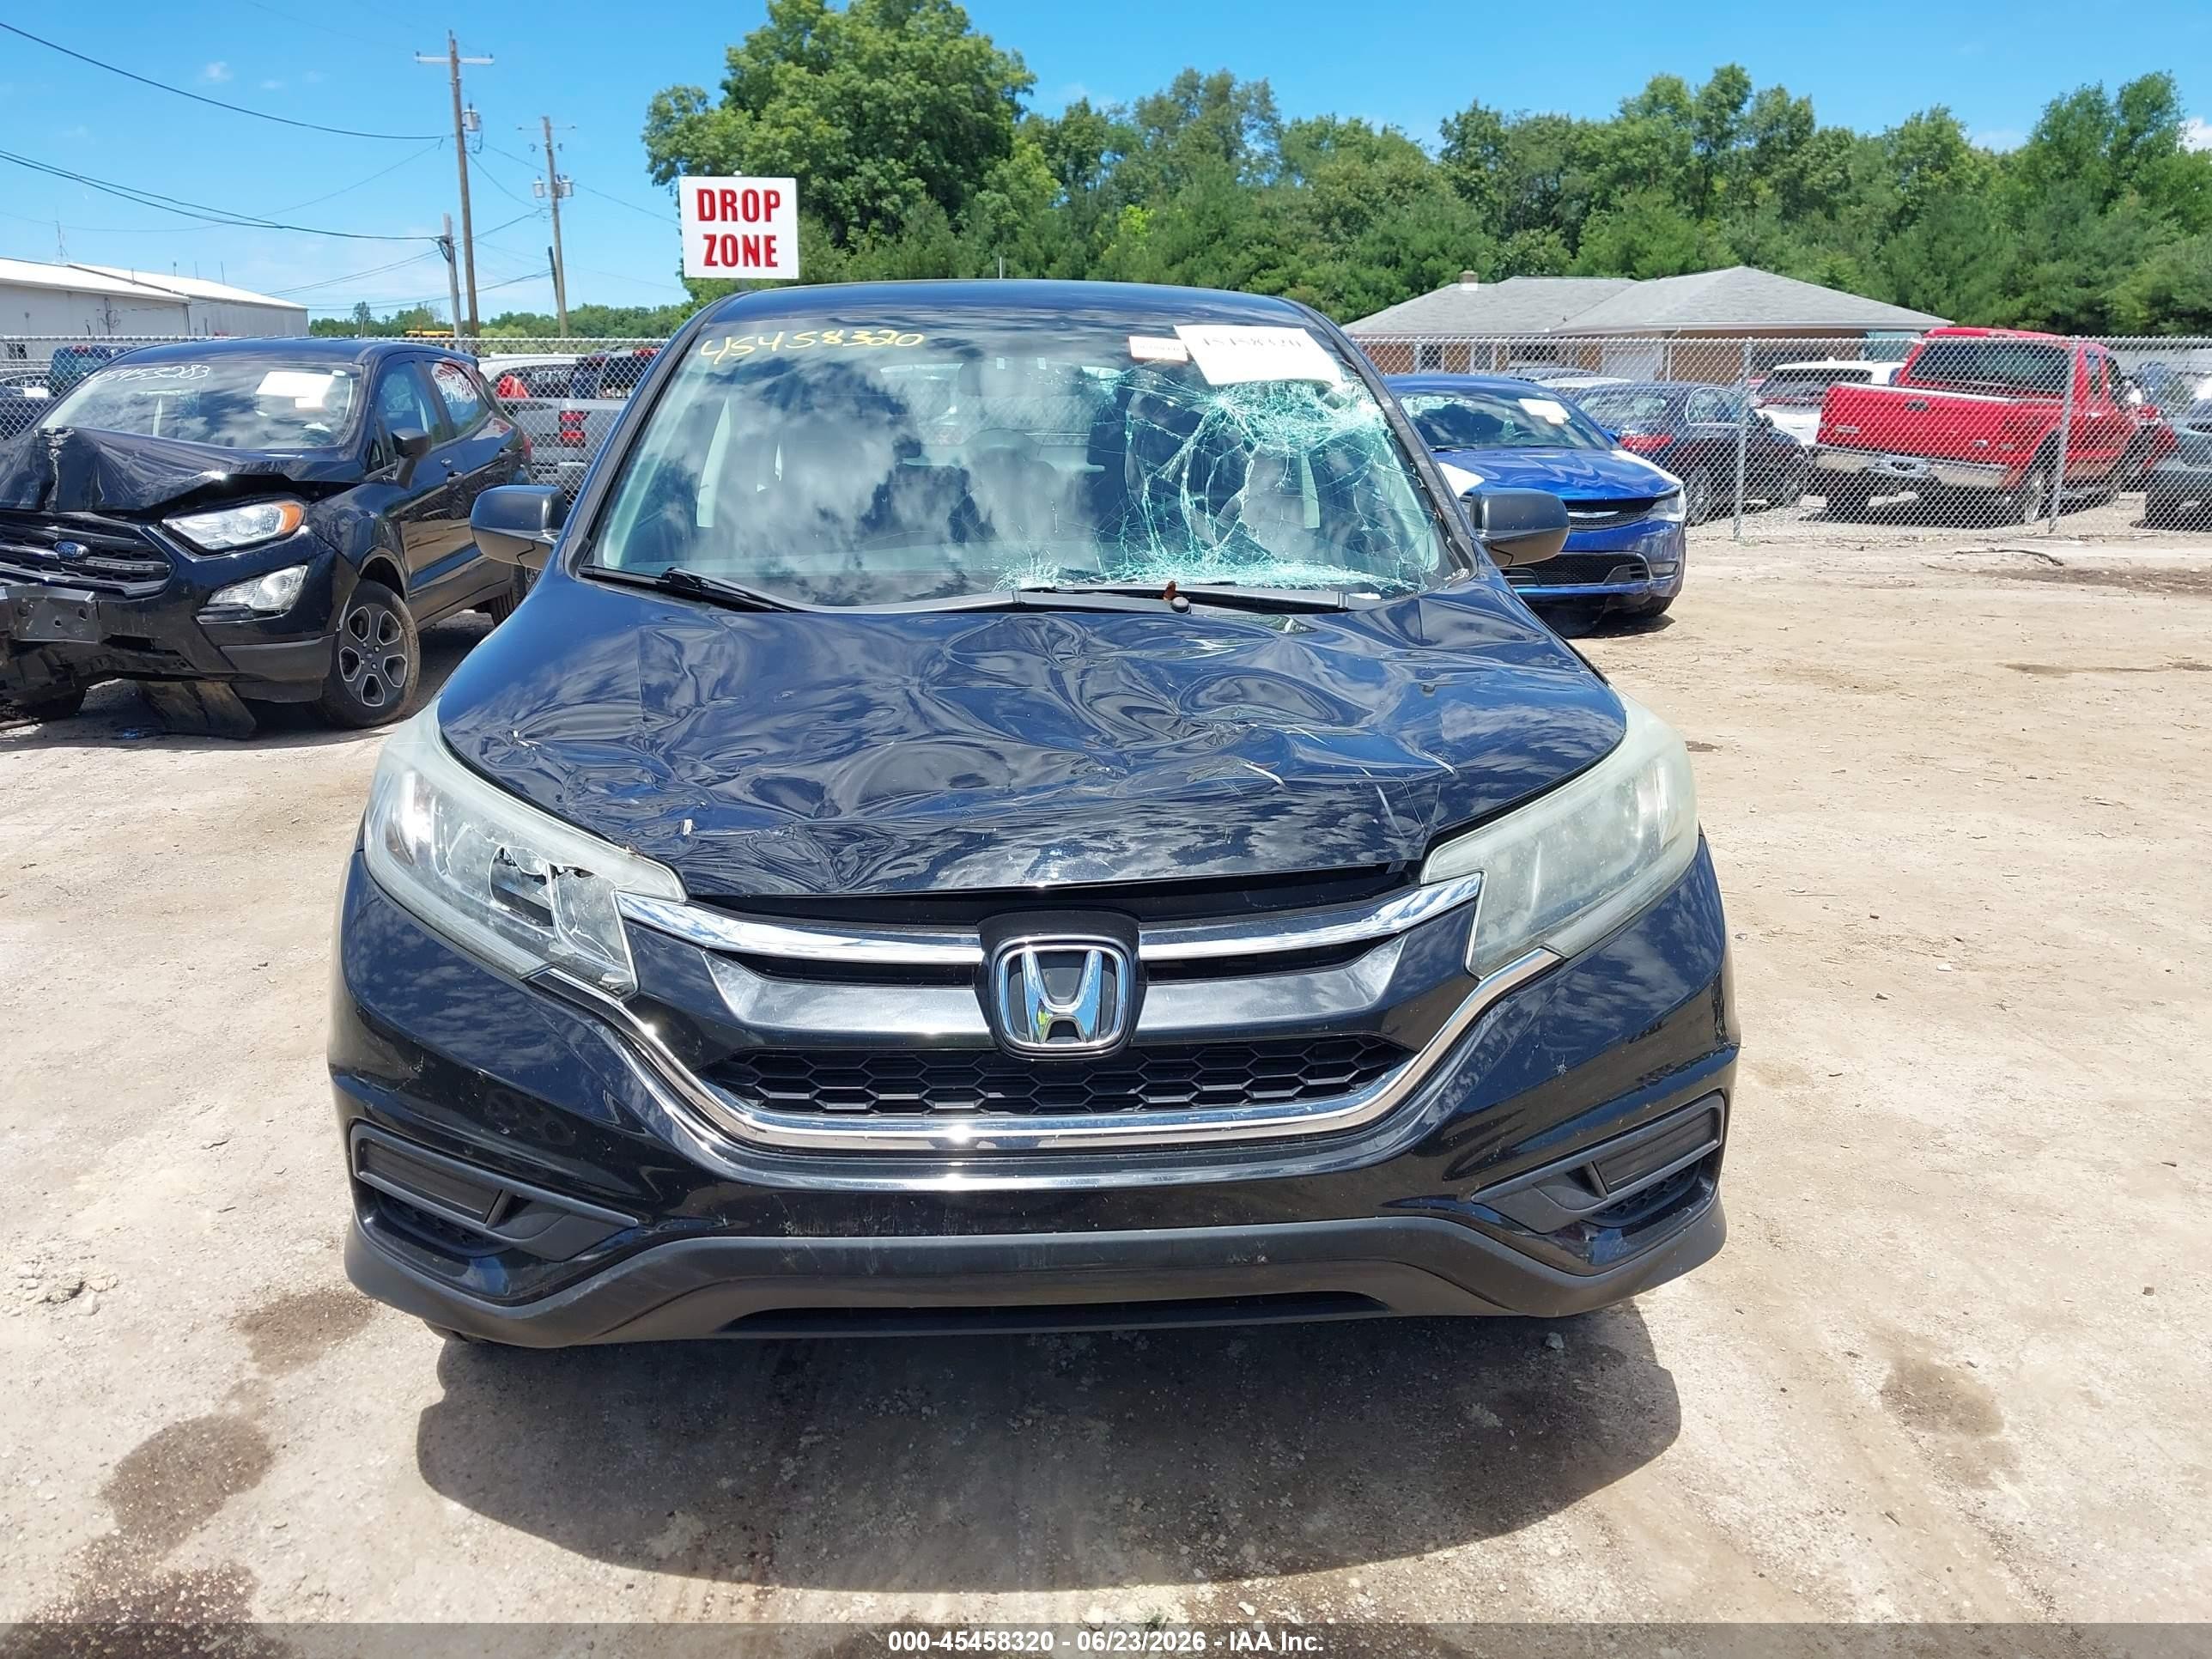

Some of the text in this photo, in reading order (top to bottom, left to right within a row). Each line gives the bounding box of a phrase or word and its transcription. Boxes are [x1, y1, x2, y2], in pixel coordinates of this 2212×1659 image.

[696, 188, 781, 222] DROP
[702, 234, 779, 267] ZONE
[700, 329, 926, 365] 45458320
